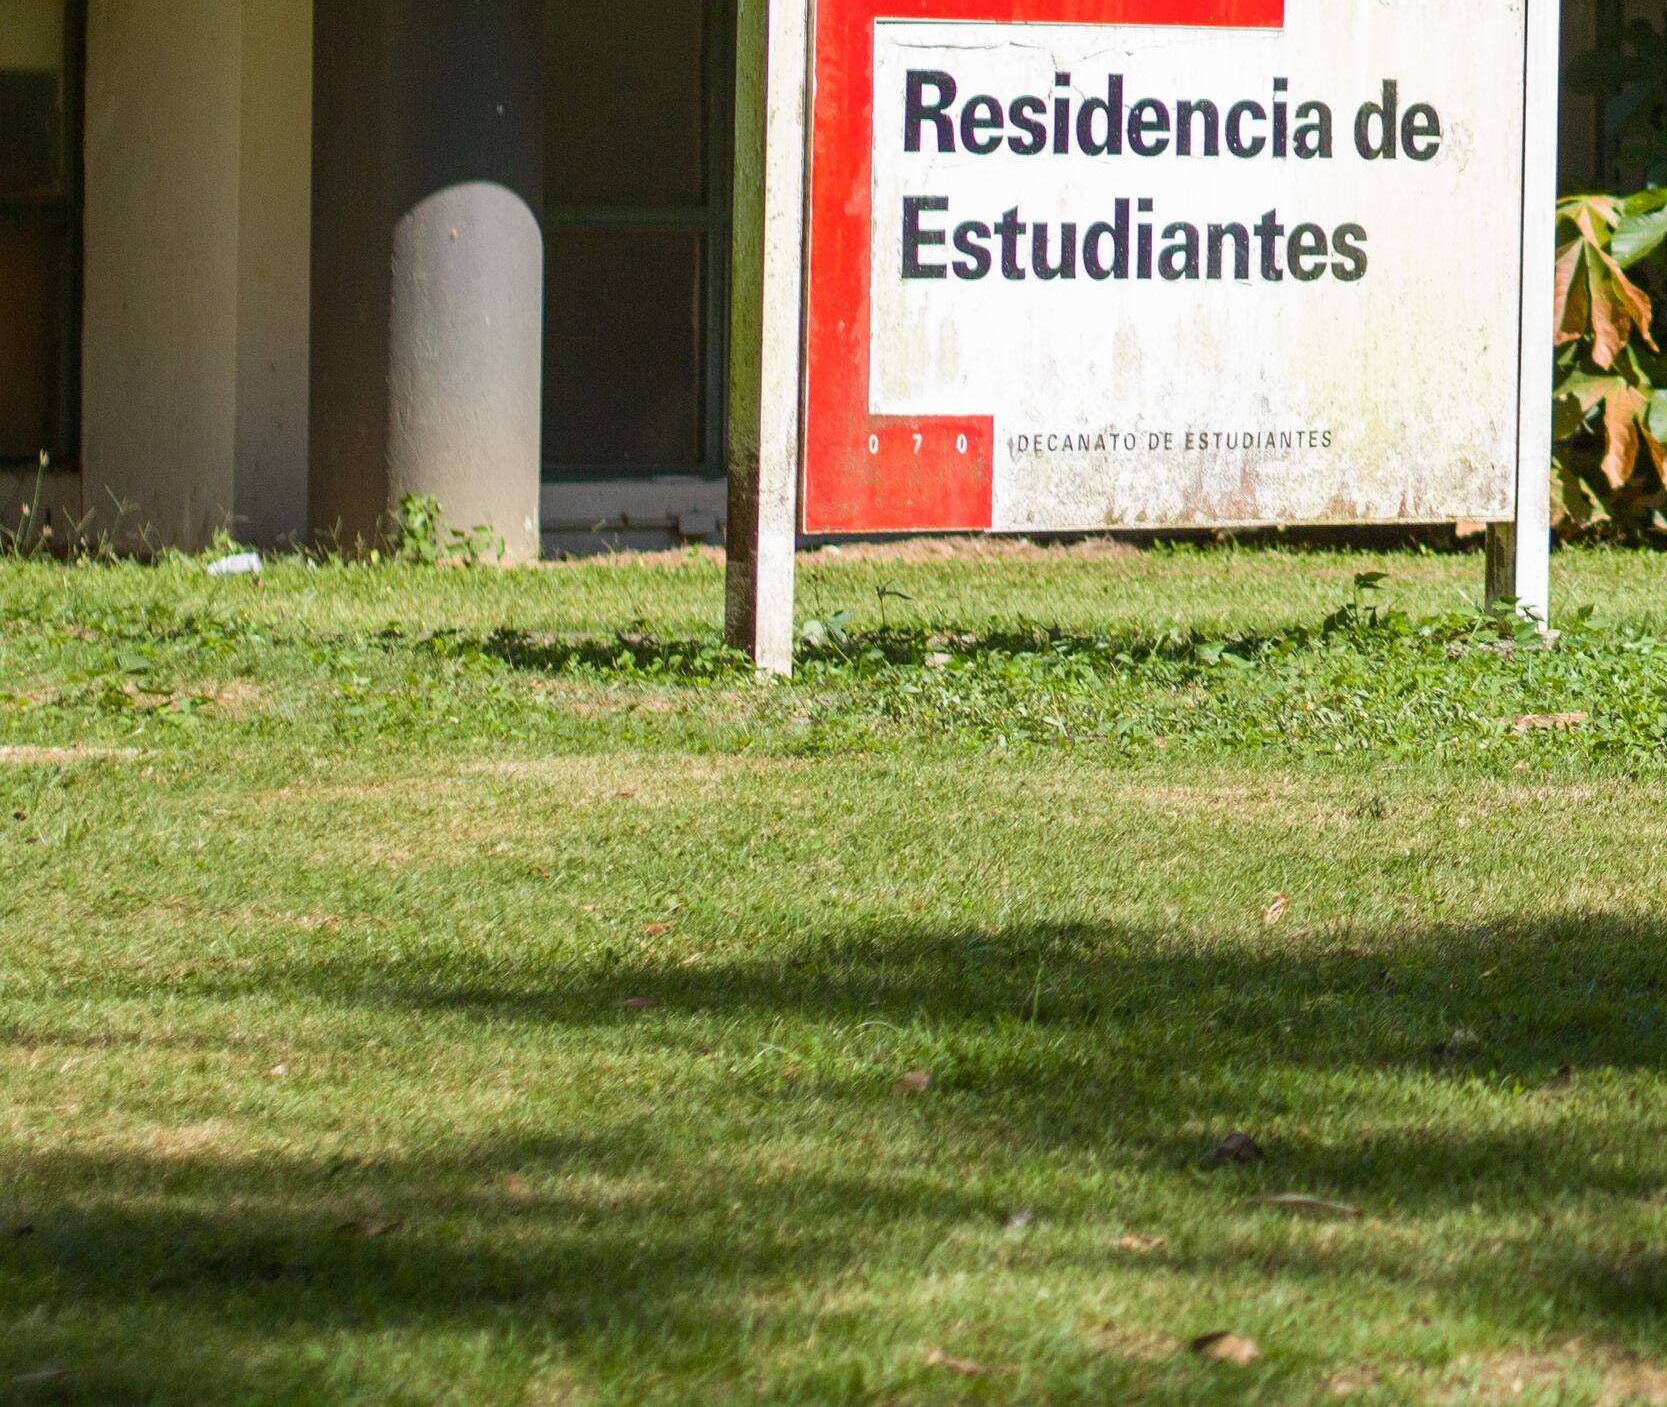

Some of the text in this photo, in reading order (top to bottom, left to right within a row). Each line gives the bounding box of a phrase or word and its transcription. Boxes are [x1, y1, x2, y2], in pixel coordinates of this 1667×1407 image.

[905, 71, 1440, 160] Residencia de
[902, 198, 1365, 281] Estudiantes
[1017, 430, 1333, 453] DECANATO DE ESTUDIANTES
